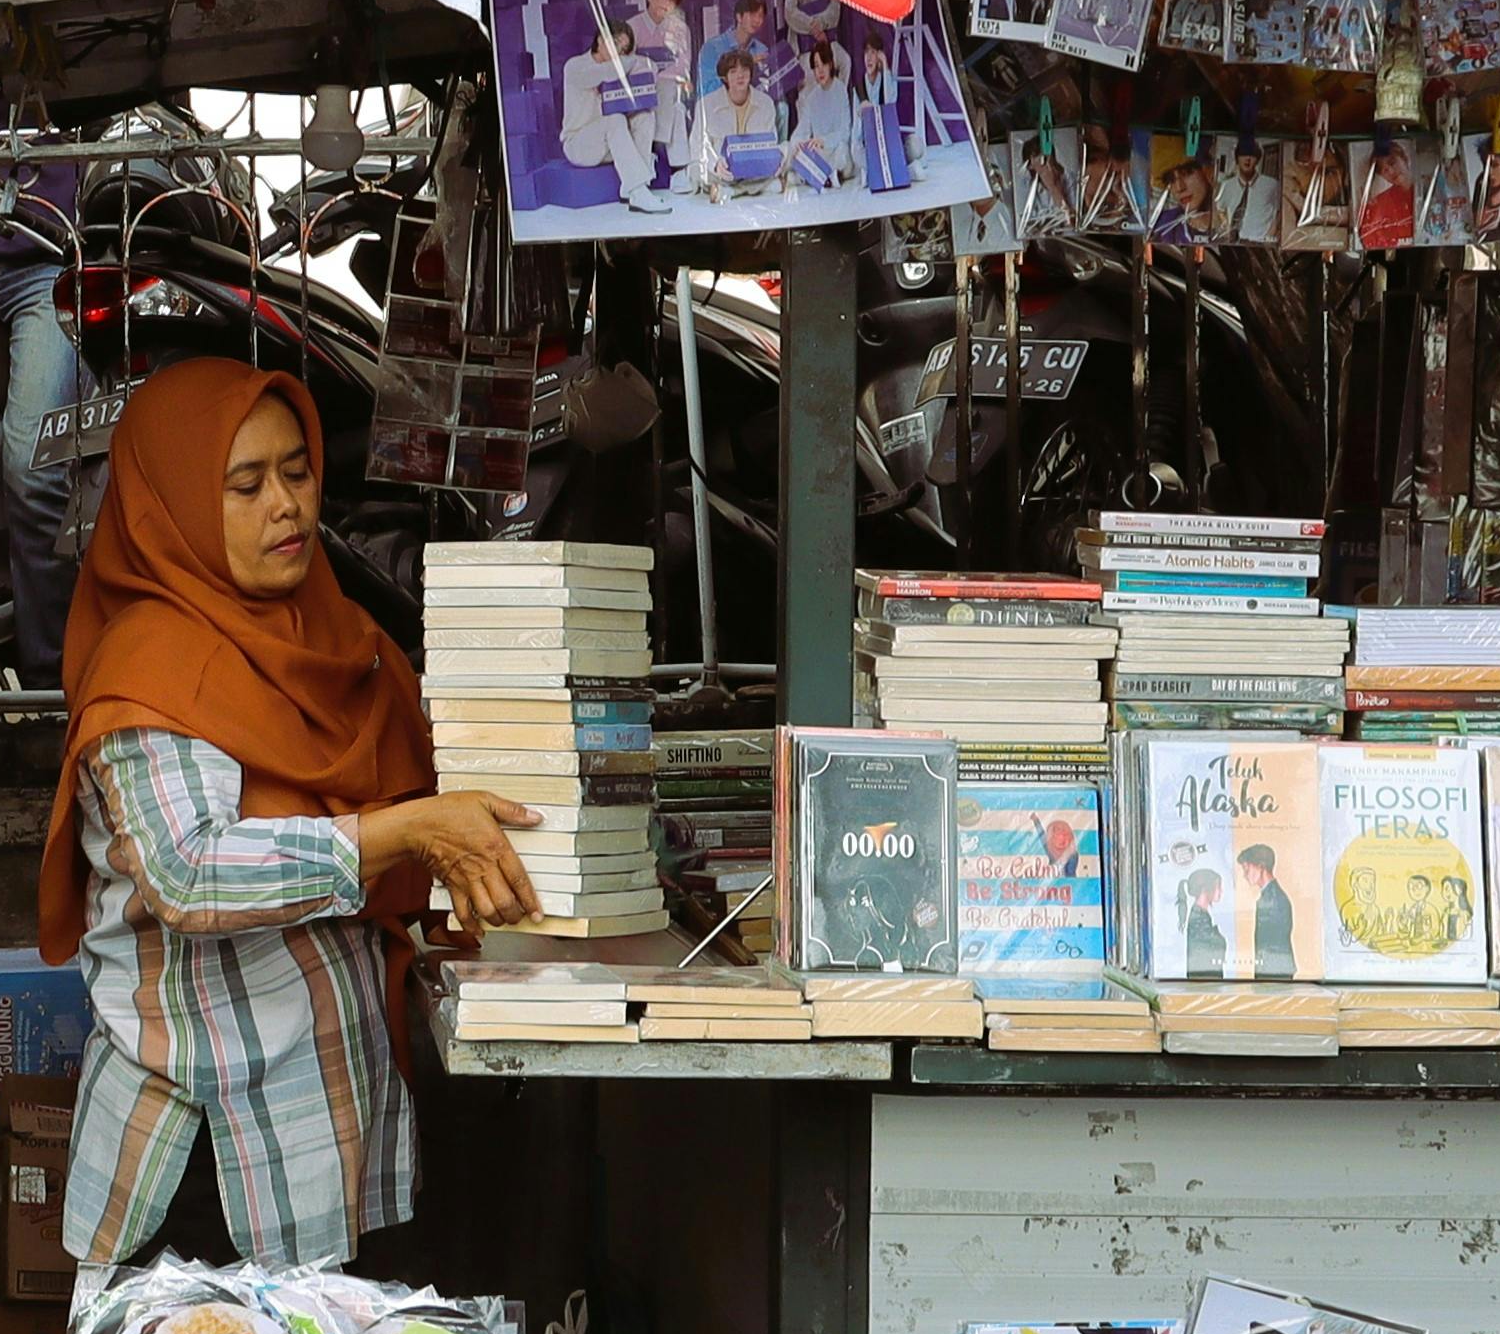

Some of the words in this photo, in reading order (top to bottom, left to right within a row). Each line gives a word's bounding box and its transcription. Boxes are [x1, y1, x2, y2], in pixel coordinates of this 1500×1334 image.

[926, 345, 954, 374] AB
[1043, 347, 1081, 369] CU
[40, 413, 69, 441] AB
[1165, 553, 1209, 569] Atomic
[1213, 555, 1255, 570] Habits
[896, 579, 922, 588] MARK
[896, 586, 933, 596] MANSON
[978, 609, 1055, 626] DUNIA
[1211, 679, 1227, 692] DAY
[1230, 680, 1239, 693] OF
[1255, 680, 1276, 693] FALSE
[667, 746, 722, 763] SHIFTING
[1208, 756, 1263, 784] Teluk
[1176, 776, 1278, 830] Alaska
[1334, 784, 1468, 812] FILOSOFI
[1354, 816, 1450, 839] TERAS
[978, 857, 1004, 878] Be
[965, 881, 995, 901] Be
[1002, 883, 1072, 904] Strong
[965, 908, 994, 927] Be
